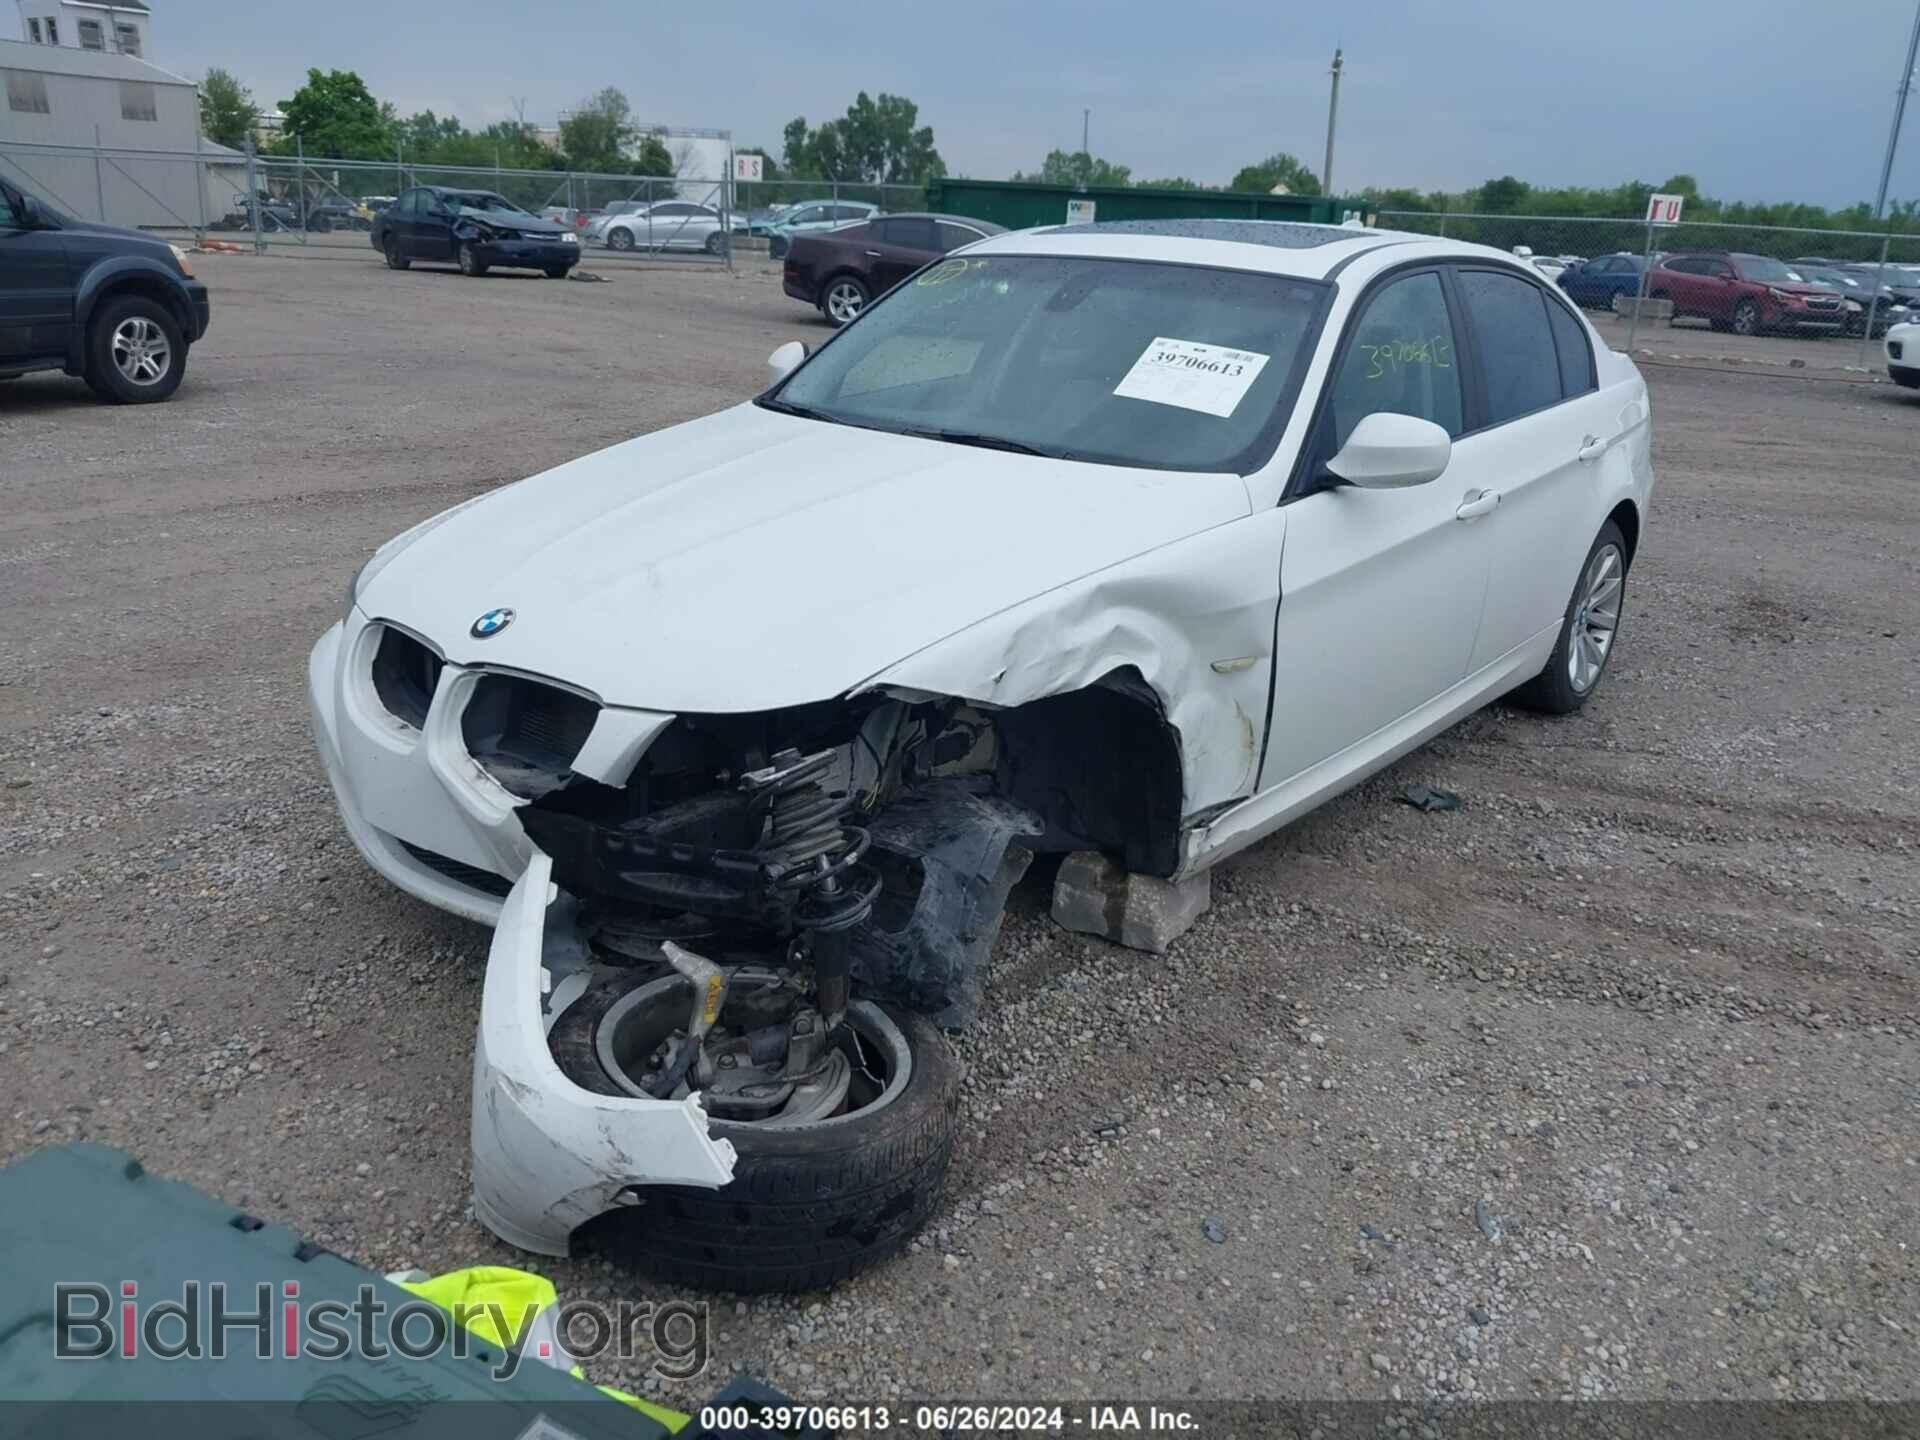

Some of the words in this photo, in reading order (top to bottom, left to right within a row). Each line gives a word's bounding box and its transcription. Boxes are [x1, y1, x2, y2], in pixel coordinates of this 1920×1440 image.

[738, 159, 747, 176] R
[752, 160, 760, 176] S
[1666, 201, 1680, 221] U
[1152, 351, 1244, 377] 39706613
